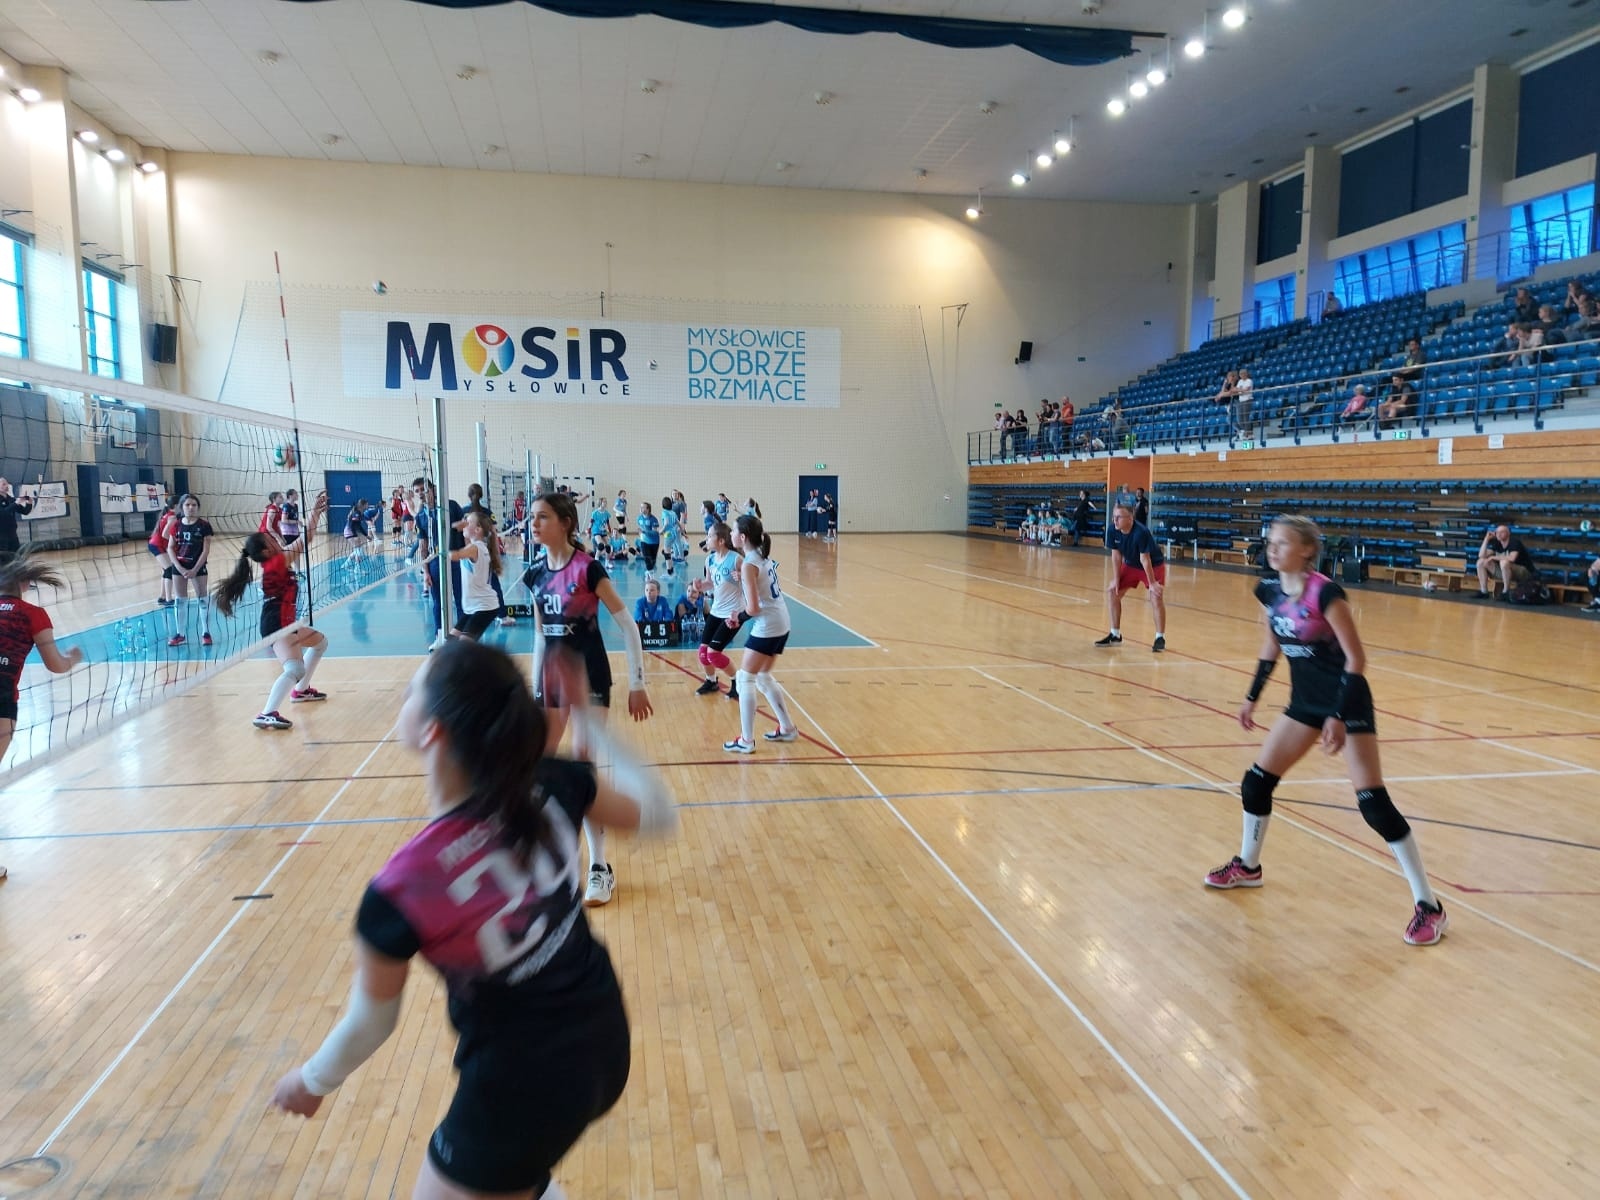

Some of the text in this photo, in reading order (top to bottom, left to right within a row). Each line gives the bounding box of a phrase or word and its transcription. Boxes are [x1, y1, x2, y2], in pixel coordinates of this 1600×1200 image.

[687, 327, 806, 349] MYSŁOWICE
[688, 348, 806, 377] DOBRZE
[688, 377, 806, 403] BRZMIĄCE
[543, 593, 562, 615] 20
[643, 624, 652, 637] 4
[659, 623, 667, 637] 5
